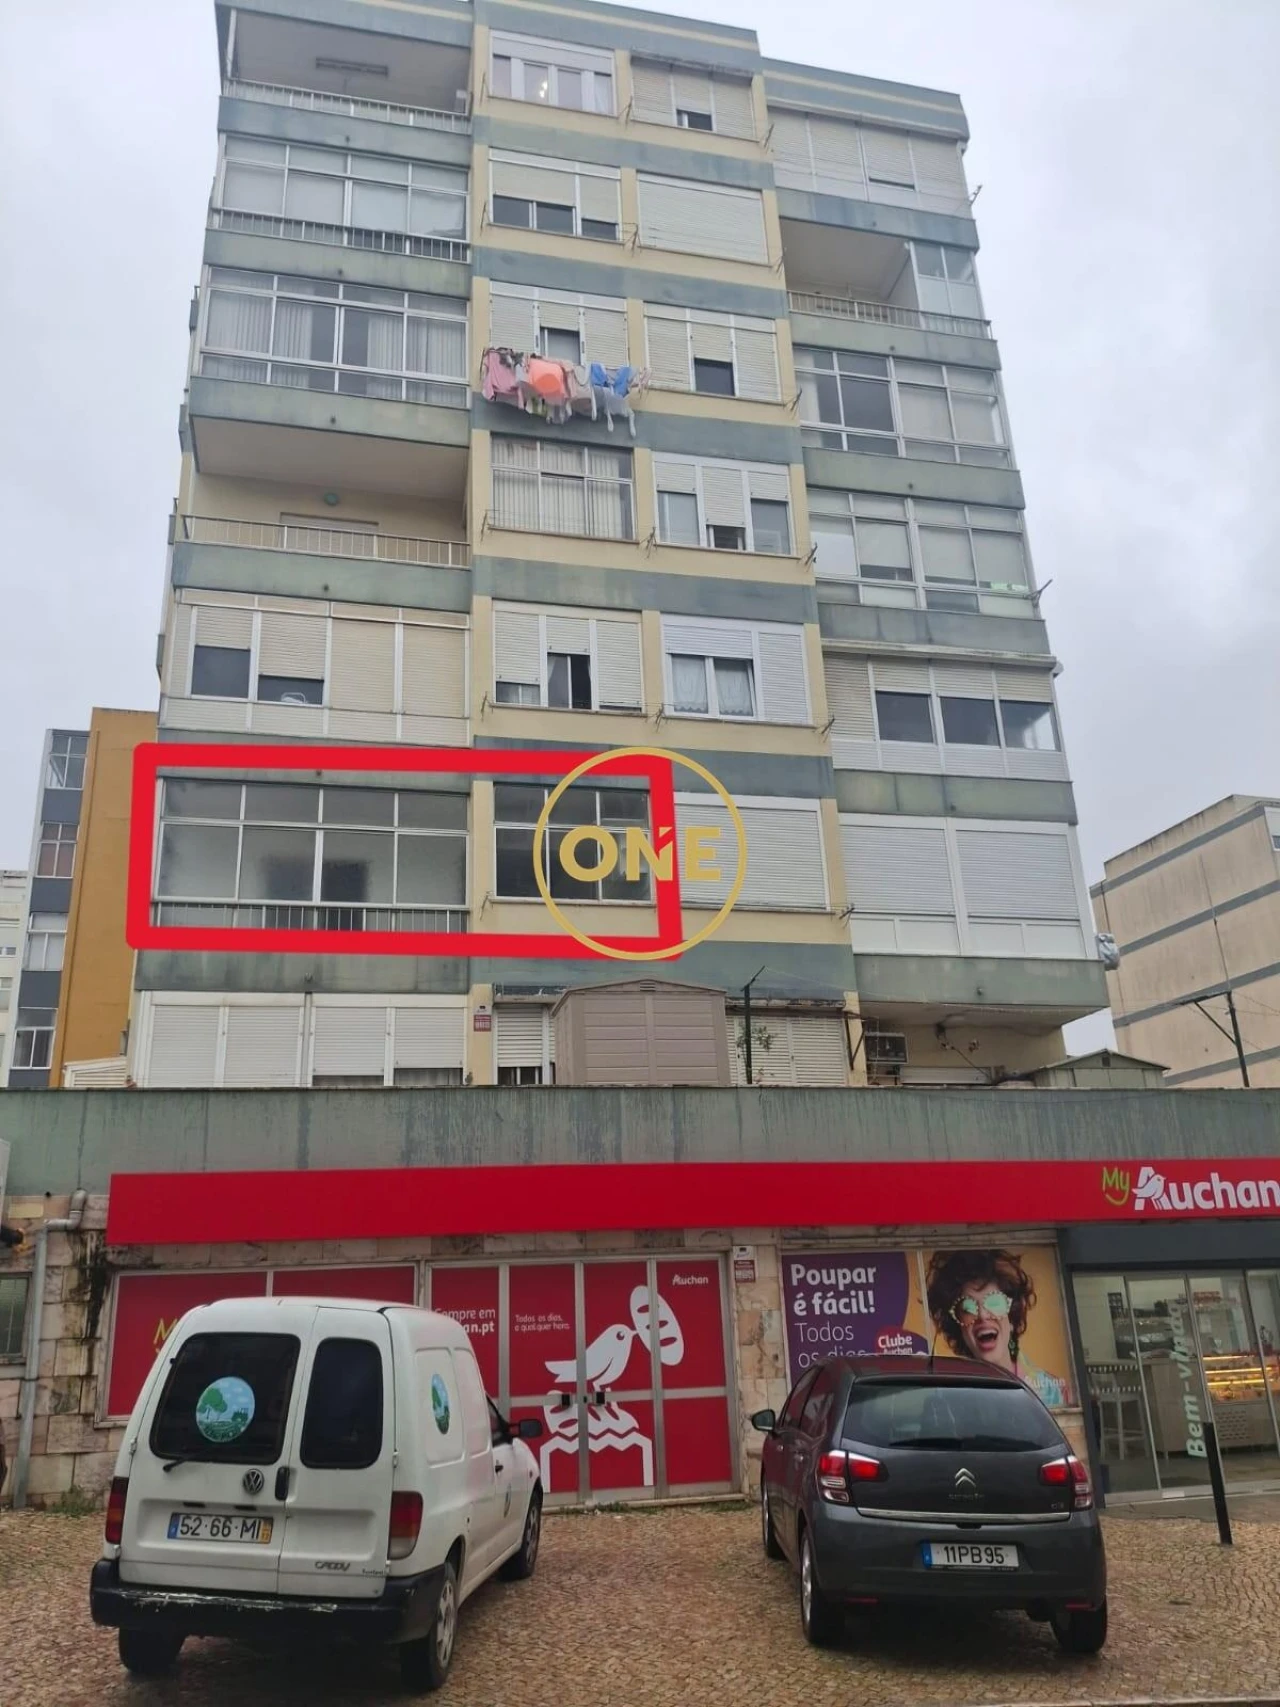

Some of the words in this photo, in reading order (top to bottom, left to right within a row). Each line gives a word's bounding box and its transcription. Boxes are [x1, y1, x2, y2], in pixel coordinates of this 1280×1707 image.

[1102, 1166, 1131, 1207] My
[1132, 1166, 1280, 1211] Auchan
[672, 1274, 709, 1286] Auchan
[790, 1263, 877, 1291] Poupar
[793, 1292, 808, 1317] é
[812, 1290, 876, 1316] fácil!
[479, 1309, 496, 1320] em
[515, 1314, 536, 1323] Todos
[794, 1320, 855, 1343] Todos
[878, 1333, 913, 1349] Clube
